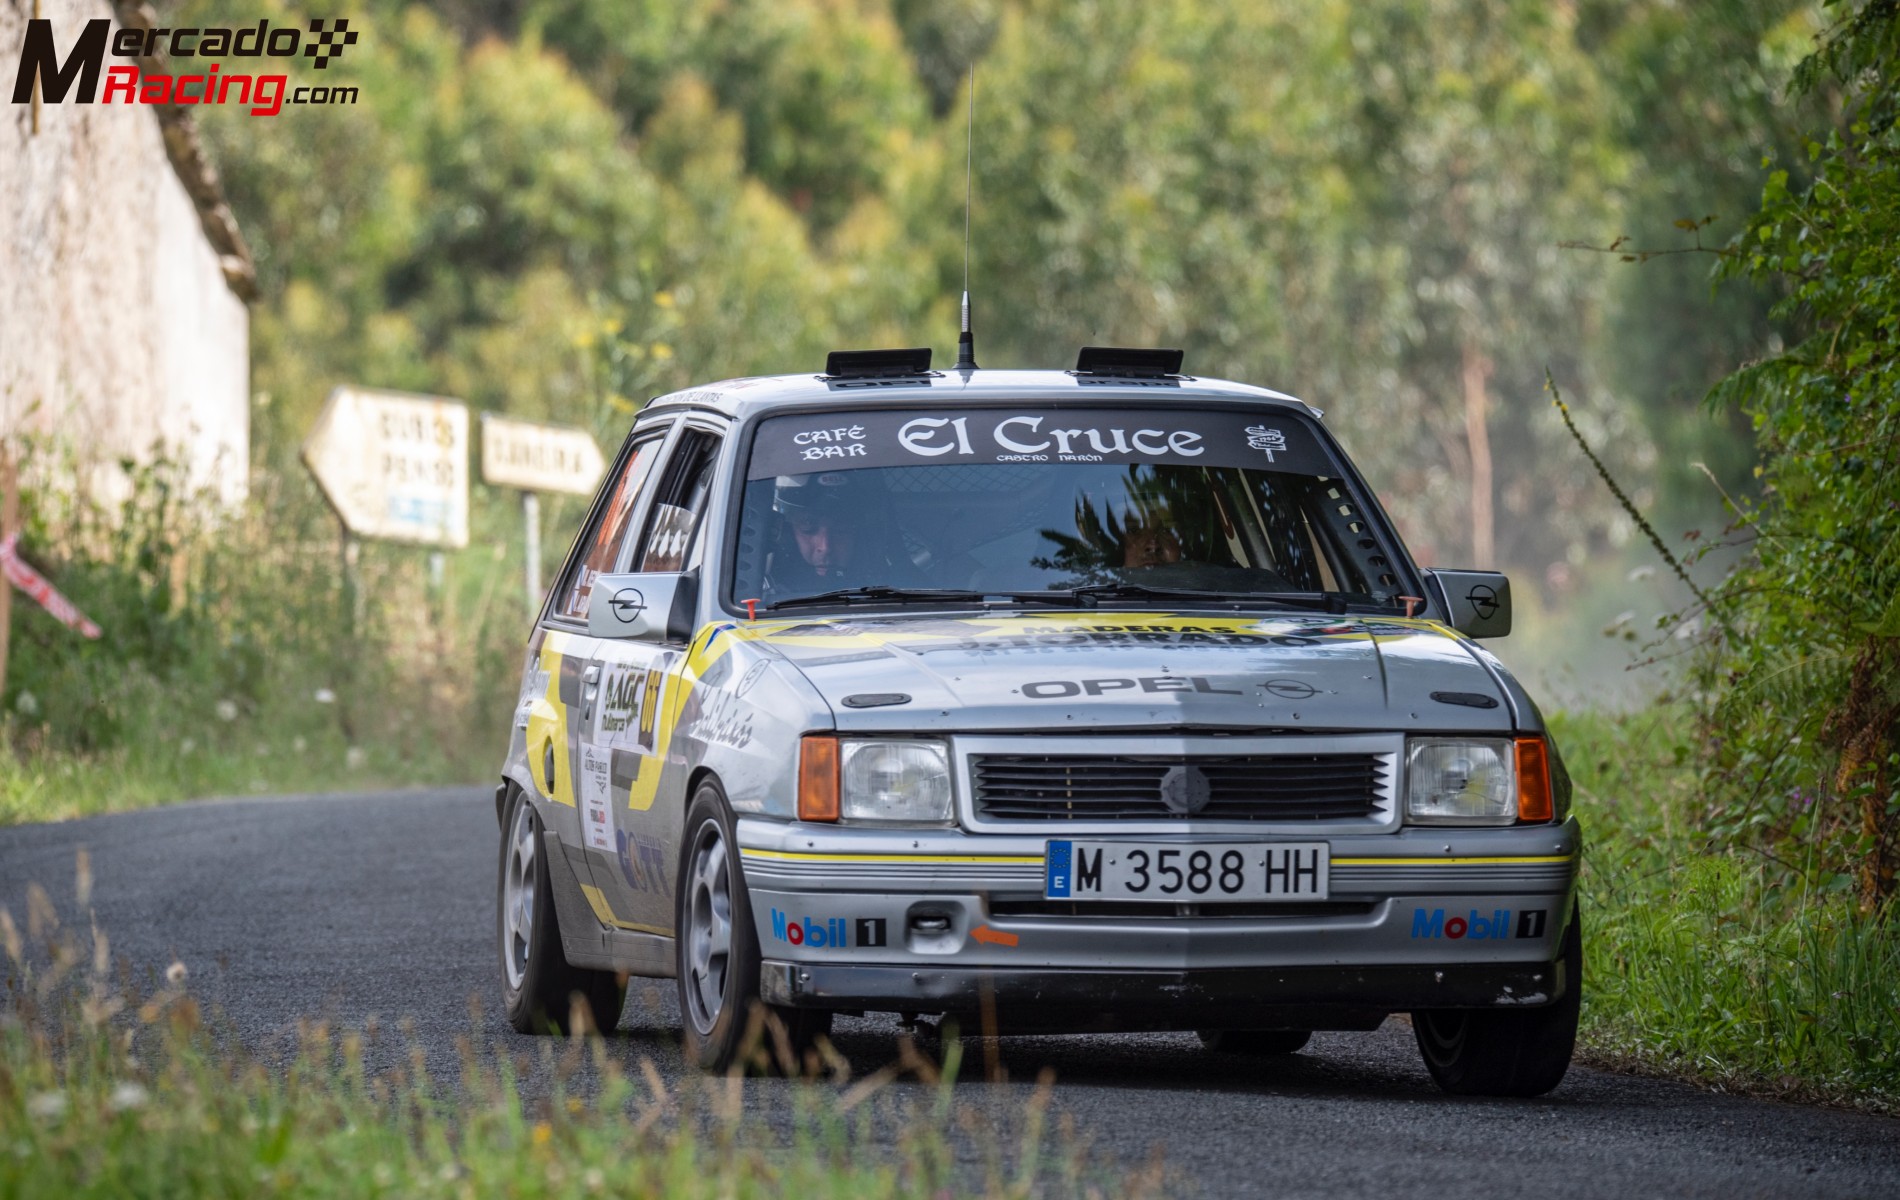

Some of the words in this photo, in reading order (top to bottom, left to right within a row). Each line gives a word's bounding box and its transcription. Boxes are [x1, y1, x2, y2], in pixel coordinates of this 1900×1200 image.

[793, 425, 867, 446] CAFÉ
[897, 417, 976, 457] El
[993, 416, 1205, 457] Cruce
[800, 442, 868, 461] BAR
[996, 454, 1049, 462] CASTRO
[1058, 453, 1103, 462] NARÓN
[1022, 625, 1238, 634] MADERAS
[1021, 677, 1243, 699] OPEL
[1053, 876, 1065, 888] E
[1076, 848, 1103, 892] M
[1124, 849, 1245, 894] 3588
[1265, 849, 1319, 893] HH
[771, 907, 847, 948] Mobil
[1411, 908, 1511, 940] Mobil
